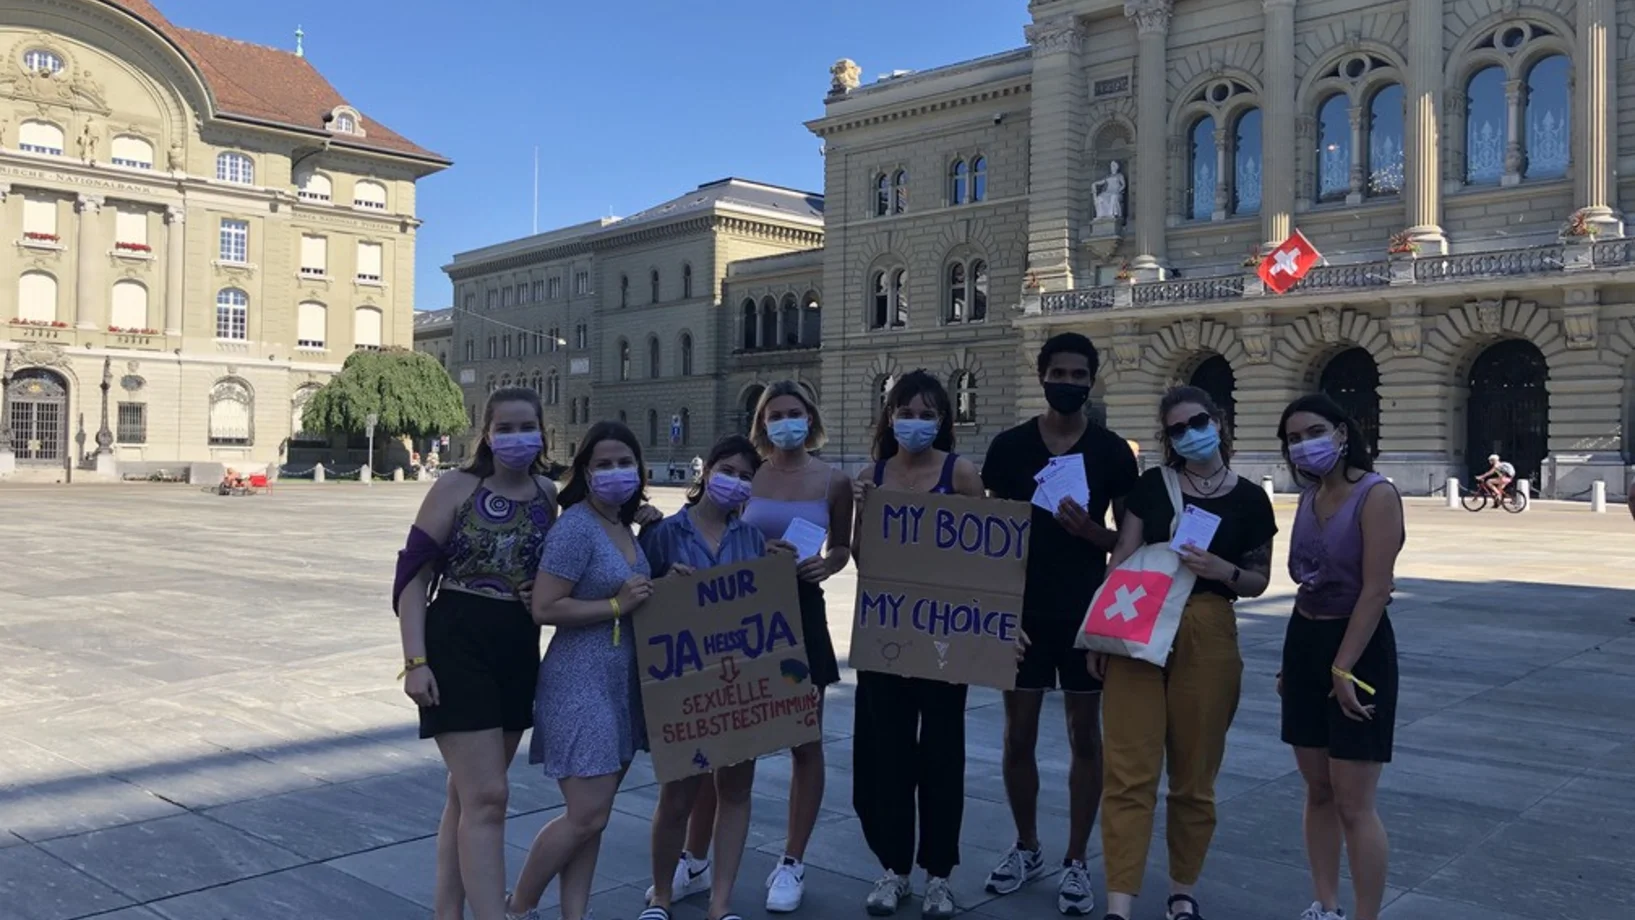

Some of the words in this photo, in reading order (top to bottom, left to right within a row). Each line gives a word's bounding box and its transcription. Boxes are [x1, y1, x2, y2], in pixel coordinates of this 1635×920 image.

[56, 173, 151, 194] NATIONALBANK
[883, 504, 925, 545] MY
[936, 508, 1031, 559] BODY
[697, 569, 757, 607] NUR
[860, 590, 906, 628] MY
[648, 629, 704, 681] JA
[703, 628, 749, 655] HEISST
[741, 611, 798, 659] JA
[682, 677, 773, 715] SEXUELLE
